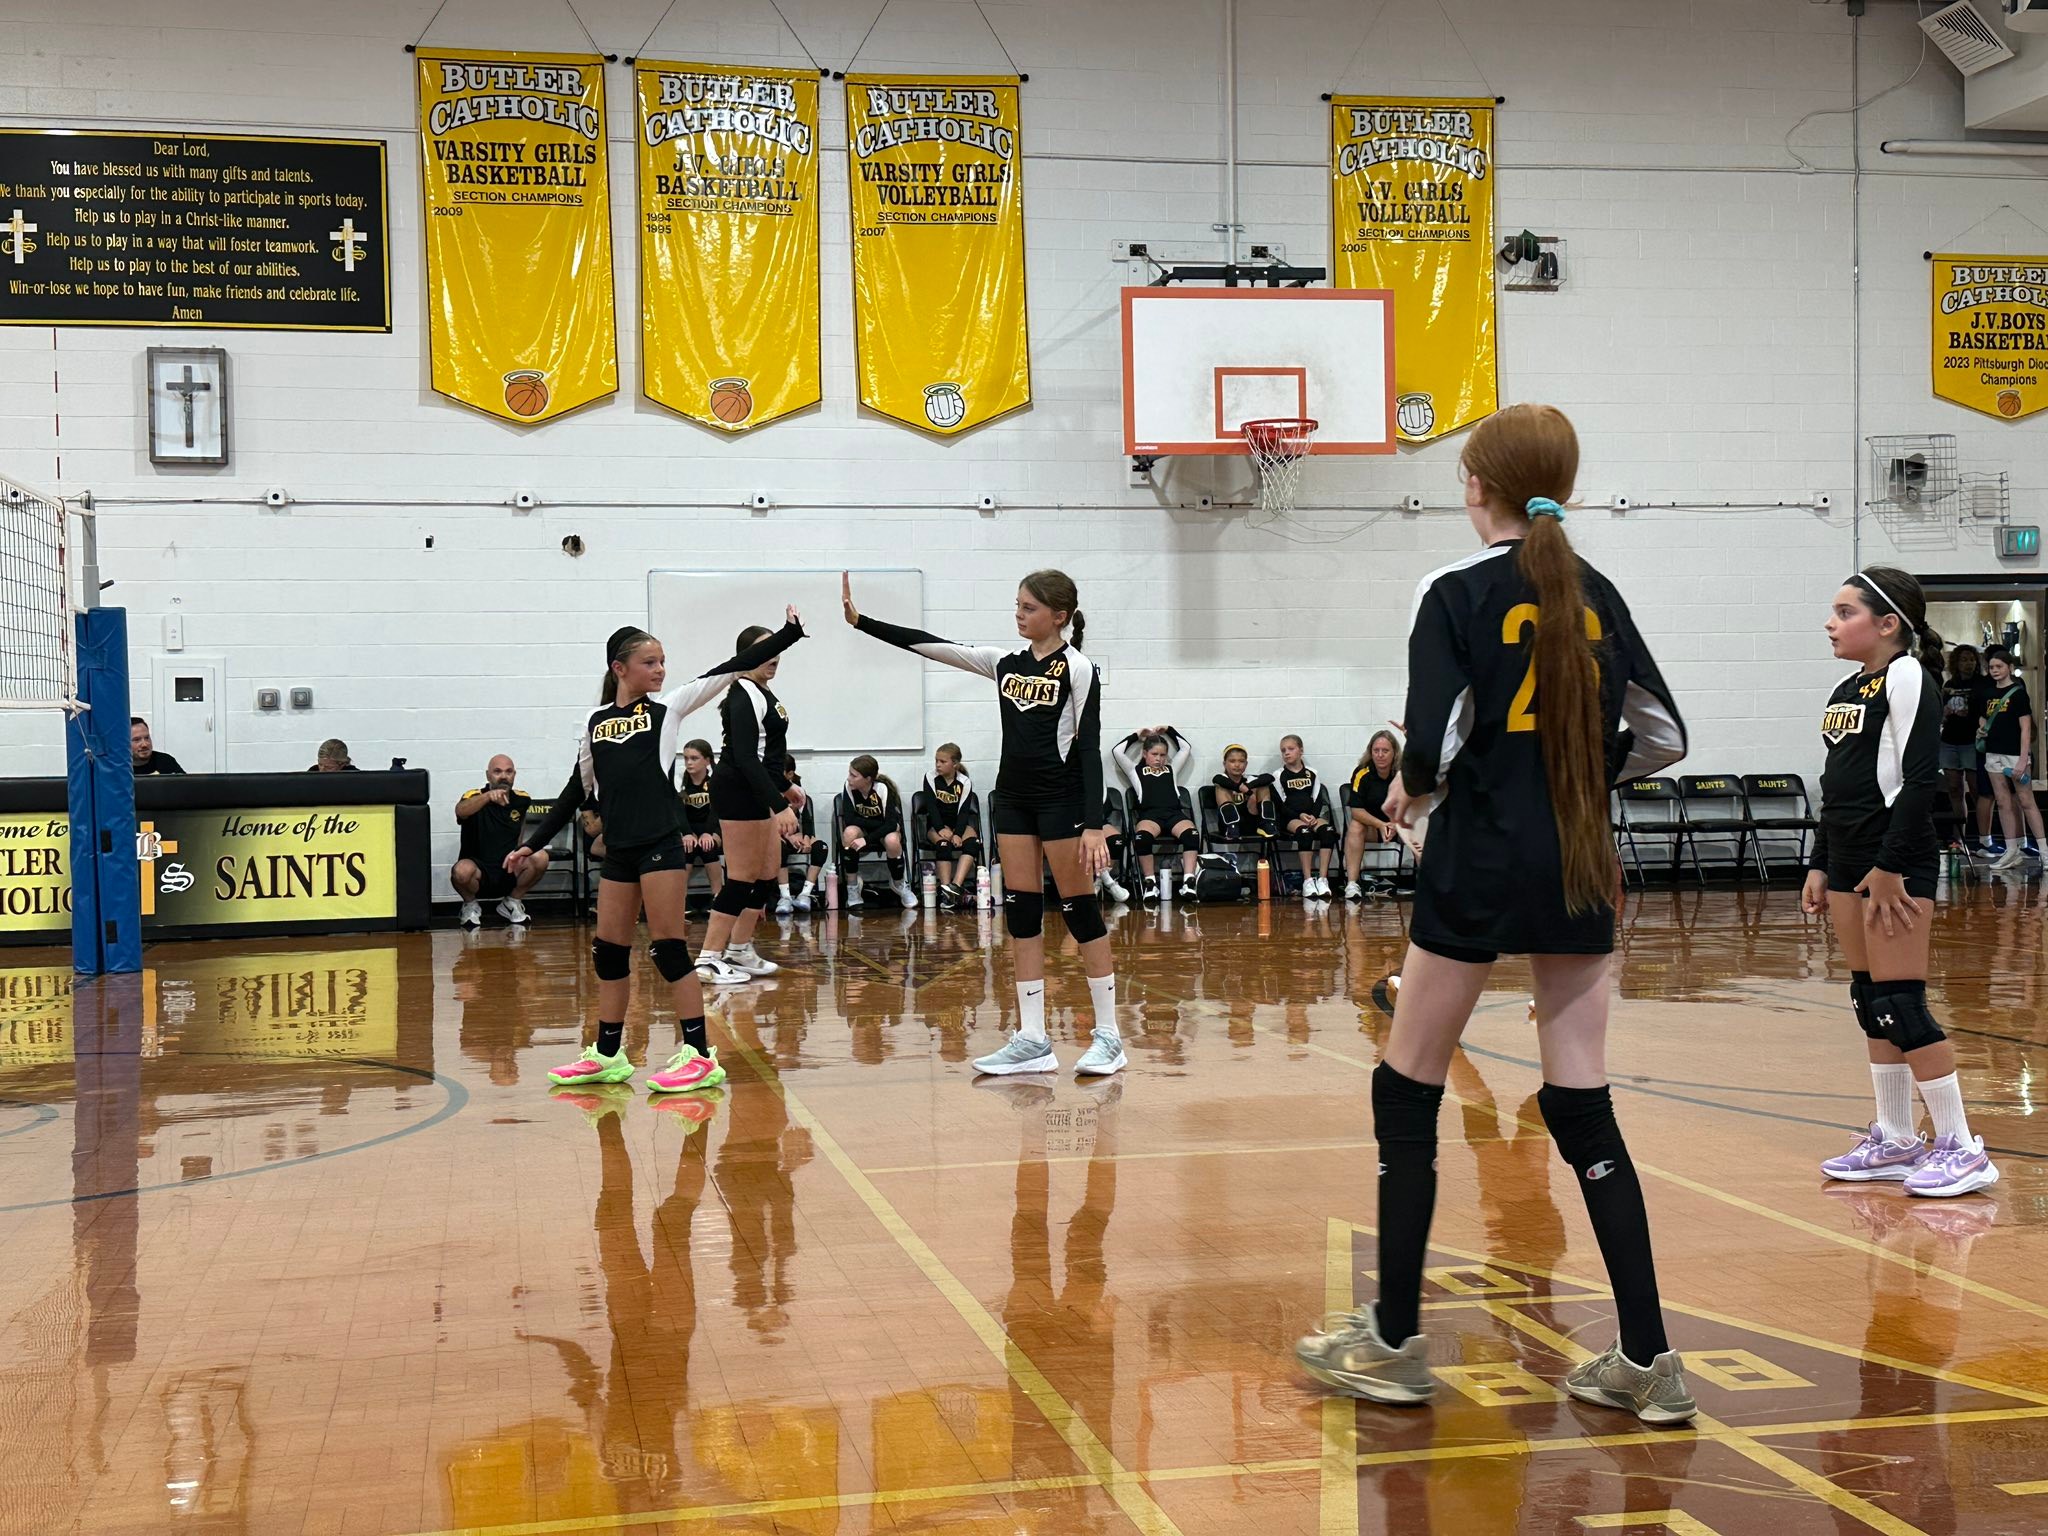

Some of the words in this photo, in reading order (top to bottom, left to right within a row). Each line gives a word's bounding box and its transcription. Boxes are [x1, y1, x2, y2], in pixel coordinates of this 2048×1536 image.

[441, 63, 584, 97] BUTLER
[659, 75, 796, 113] BUTLER
[866, 88, 999, 119] BUTLER
[430, 95, 599, 140] CATHOLIC
[1350, 110, 1474, 140] BUTLER
[645, 107, 810, 155] CATHOLIC
[856, 118, 1014, 159] CATHOLIC
[154, 141, 179, 155] Dear
[183, 142, 210, 157] Lord,
[433, 140, 525, 162] VARSITY
[534, 144, 596, 164] GIRLS
[1339, 137, 1486, 180] CATHOLIC
[50, 160, 70, 175] You
[74, 161, 99, 176] have
[102, 162, 141, 177] blessed
[146, 165, 158, 177] us
[162, 164, 185, 178] with
[190, 167, 218, 182] many
[222, 166, 247, 184] gifts
[251, 168, 270, 181] and
[275, 169, 313, 182] talents.
[446, 164, 587, 187] BASKETBALL
[859, 162, 946, 182] VARSITY
[952, 163, 1011, 183] GIRLS
[15, 184, 46, 198] thank
[51, 187, 70, 201] you
[74, 185, 126, 202] especially
[131, 186, 146, 200] for
[150, 186, 168, 200] the
[171, 187, 204, 205] ability
[209, 189, 220, 202] to
[224, 190, 280, 208] participate
[285, 192, 294, 205] in
[298, 193, 331, 209] sports
[335, 193, 367, 210] today.
[453, 191, 505, 201] SECTION
[511, 192, 582, 204] CHAMPIONS
[655, 175, 800, 200] BASKETBALL
[877, 184, 997, 206] VOLLEYBALL
[1404, 181, 1463, 201] GIRLS
[434, 206, 463, 216] 2009
[667, 198, 718, 208] SECTION
[723, 201, 791, 213] CHAMPIONS
[1358, 202, 1470, 223] VOLLEYBALL
[75, 208, 99, 226] Help
[103, 212, 116, 223] us
[120, 210, 130, 223] to
[135, 210, 157, 227] play
[161, 211, 171, 225] in
[175, 214, 182, 225] a
[186, 212, 242, 228] Christ-like
[247, 216, 289, 229] manner.
[646, 212, 671, 222] 1994
[877, 212, 926, 222] SECTION
[931, 212, 996, 222] CHAMPIONS
[646, 224, 671, 234] 1995
[861, 227, 885, 236] 2007
[1358, 228, 1403, 238] SECTION
[1408, 229, 1470, 239] CHAMPIONS
[46, 232, 70, 249] Help
[74, 235, 87, 247] us
[91, 233, 102, 247] to
[106, 233, 128, 251] play
[132, 234, 143, 248] in
[147, 237, 153, 248] a
[157, 237, 178, 252] way
[182, 236, 204, 250] that
[208, 237, 226, 251] will
[231, 237, 260, 252] foster
[265, 239, 319, 254] teamwork.
[70, 257, 93, 274] Help
[98, 260, 110, 271] us
[114, 258, 125, 271] to
[130, 258, 151, 275] play
[156, 259, 166, 272] to
[170, 260, 188, 273] the
[192, 260, 215, 274] best
[219, 261, 230, 275] of
[234, 264, 252, 276] our
[256, 262, 300, 277] abilities.
[1951, 265, 2048, 287] BUTLE
[10, 280, 70, 295] Win-or-lose
[75, 283, 89, 295] we
[93, 281, 119, 299] hope
[123, 282, 134, 295] to
[138, 282, 163, 296] have
[167, 282, 189, 298] fun,
[193, 285, 222, 299] make
[226, 285, 262, 300] friends
[266, 287, 285, 300] and
[289, 287, 337, 301] celebrate
[340, 288, 360, 302] life.
[1941, 285, 2048, 315] CATHOL
[172, 305, 203, 320] Amen
[1948, 332, 2048, 350] BASKETBA
[1943, 357, 1970, 369] 2023
[1974, 357, 2025, 372] Pittsburgh
[1980, 373, 2037, 387] Champions
[1045, 660, 1066, 678] 28
[1502, 603, 1602, 732] 2
[1005, 679, 1052, 702] SAINTS
[1859, 676, 1885, 698] 49
[596, 716, 648, 739] SAINTS
[1633, 782, 1661, 791] SAINTS
[1695, 781, 1726, 790] SAINTS
[1758, 780, 1788, 789] SAINTS
[46, 819, 69, 838] to
[222, 815, 290, 836] Home
[292, 814, 322, 842] of
[323, 814, 360, 835] the
[215, 852, 366, 901] SAINTS
